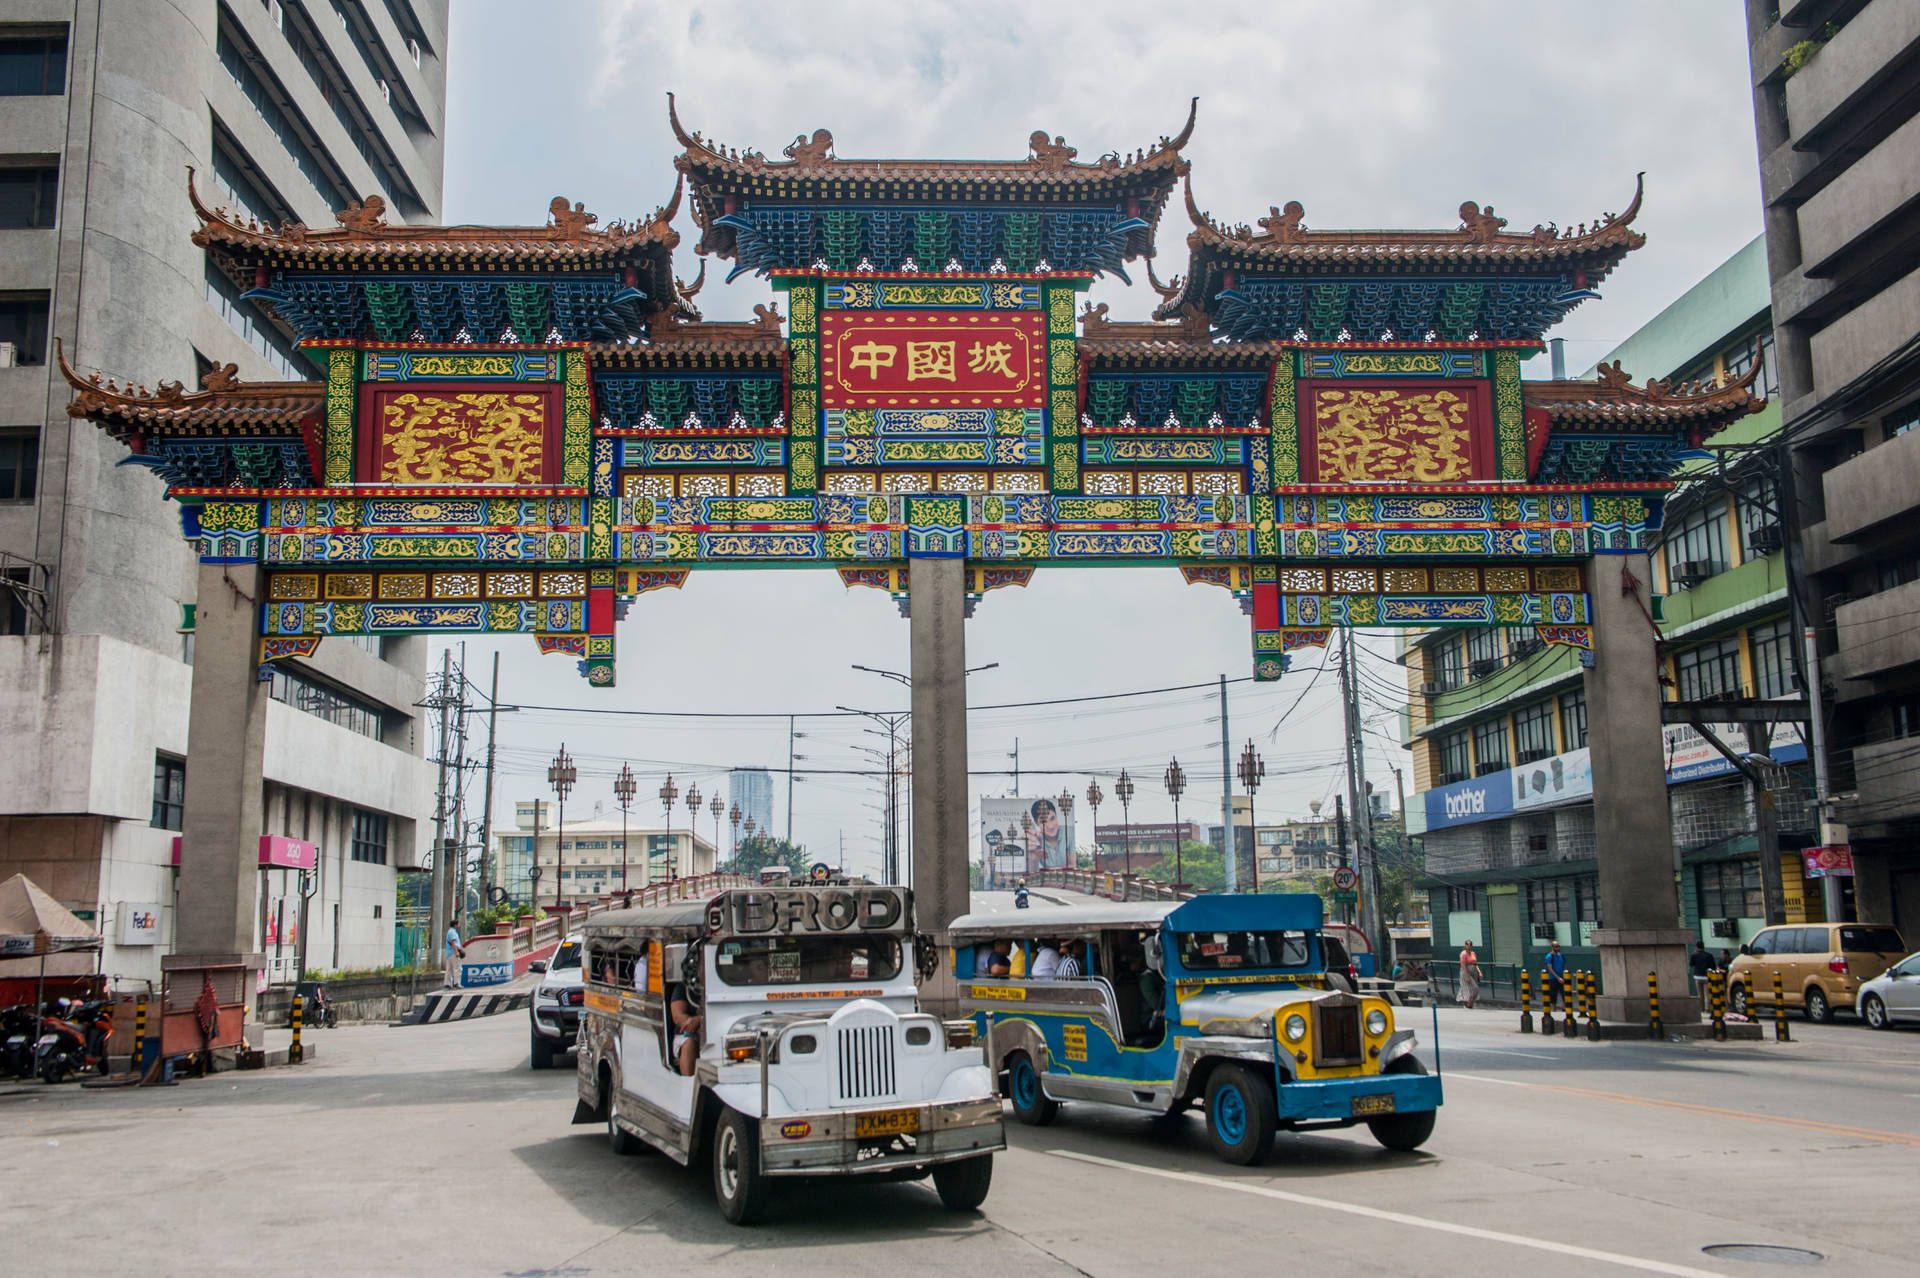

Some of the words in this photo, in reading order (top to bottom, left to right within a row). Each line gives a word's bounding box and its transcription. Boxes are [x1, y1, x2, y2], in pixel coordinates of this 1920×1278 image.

[849, 341, 1018, 382] 中國城
[1445, 787, 1485, 819] brother
[287, 843, 300, 859] 2GO
[132, 911, 155, 929] FedEx
[733, 889, 901, 933] BROD
